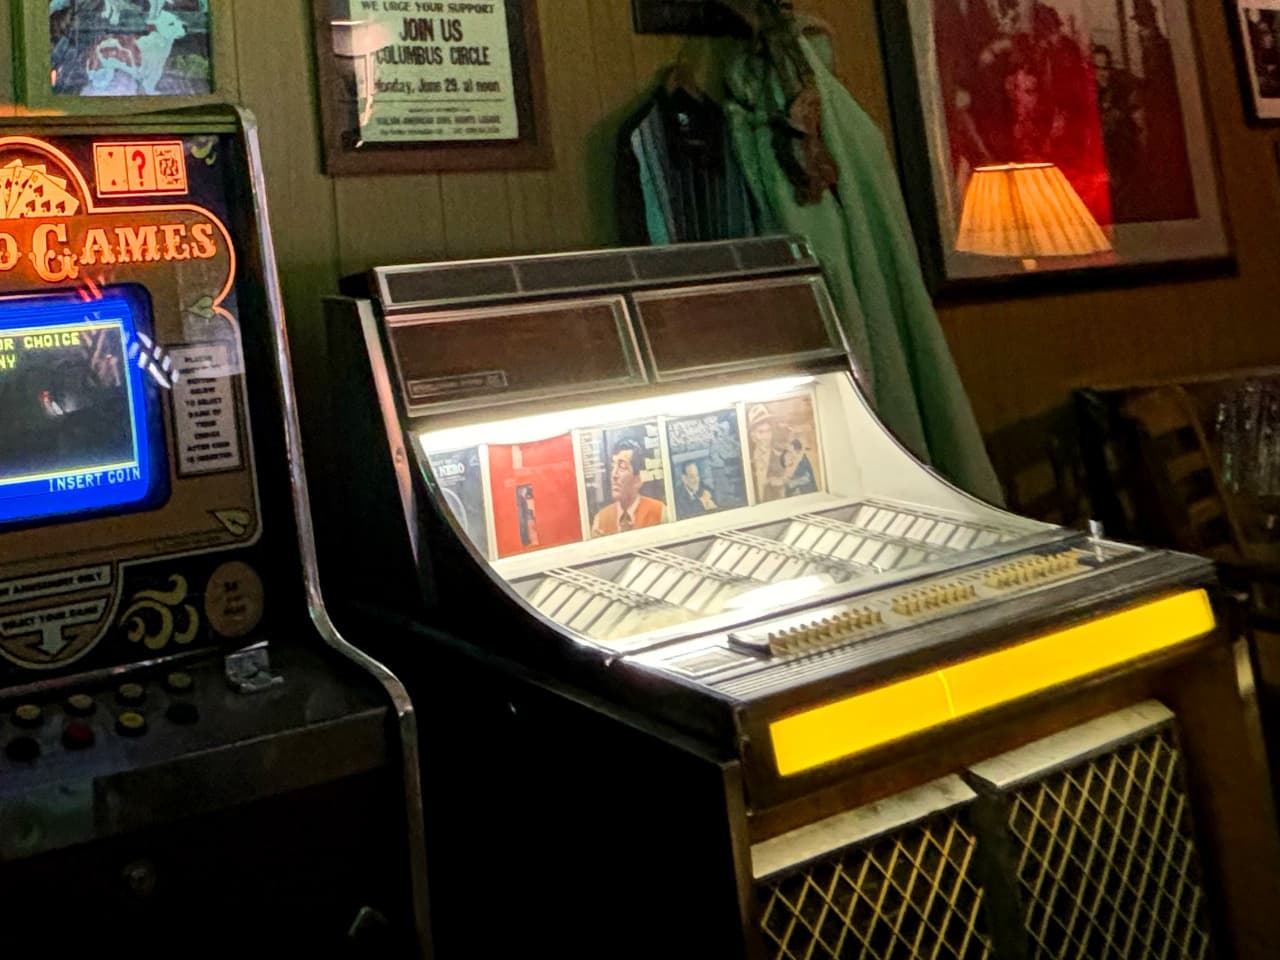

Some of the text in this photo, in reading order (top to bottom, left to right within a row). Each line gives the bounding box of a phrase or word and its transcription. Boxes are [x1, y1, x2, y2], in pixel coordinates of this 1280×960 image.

[415, 2, 443, 13] YOUR
[447, 3, 496, 14] SUPPORT
[399, 17, 464, 42] JOIN US
[376, 45, 491, 66] COLUMBUS CIRCLE
[29, 222, 218, 283] GAMES
[23, 332, 80, 349] CHOICE
[49, 467, 141, 493] INSERT COIN
